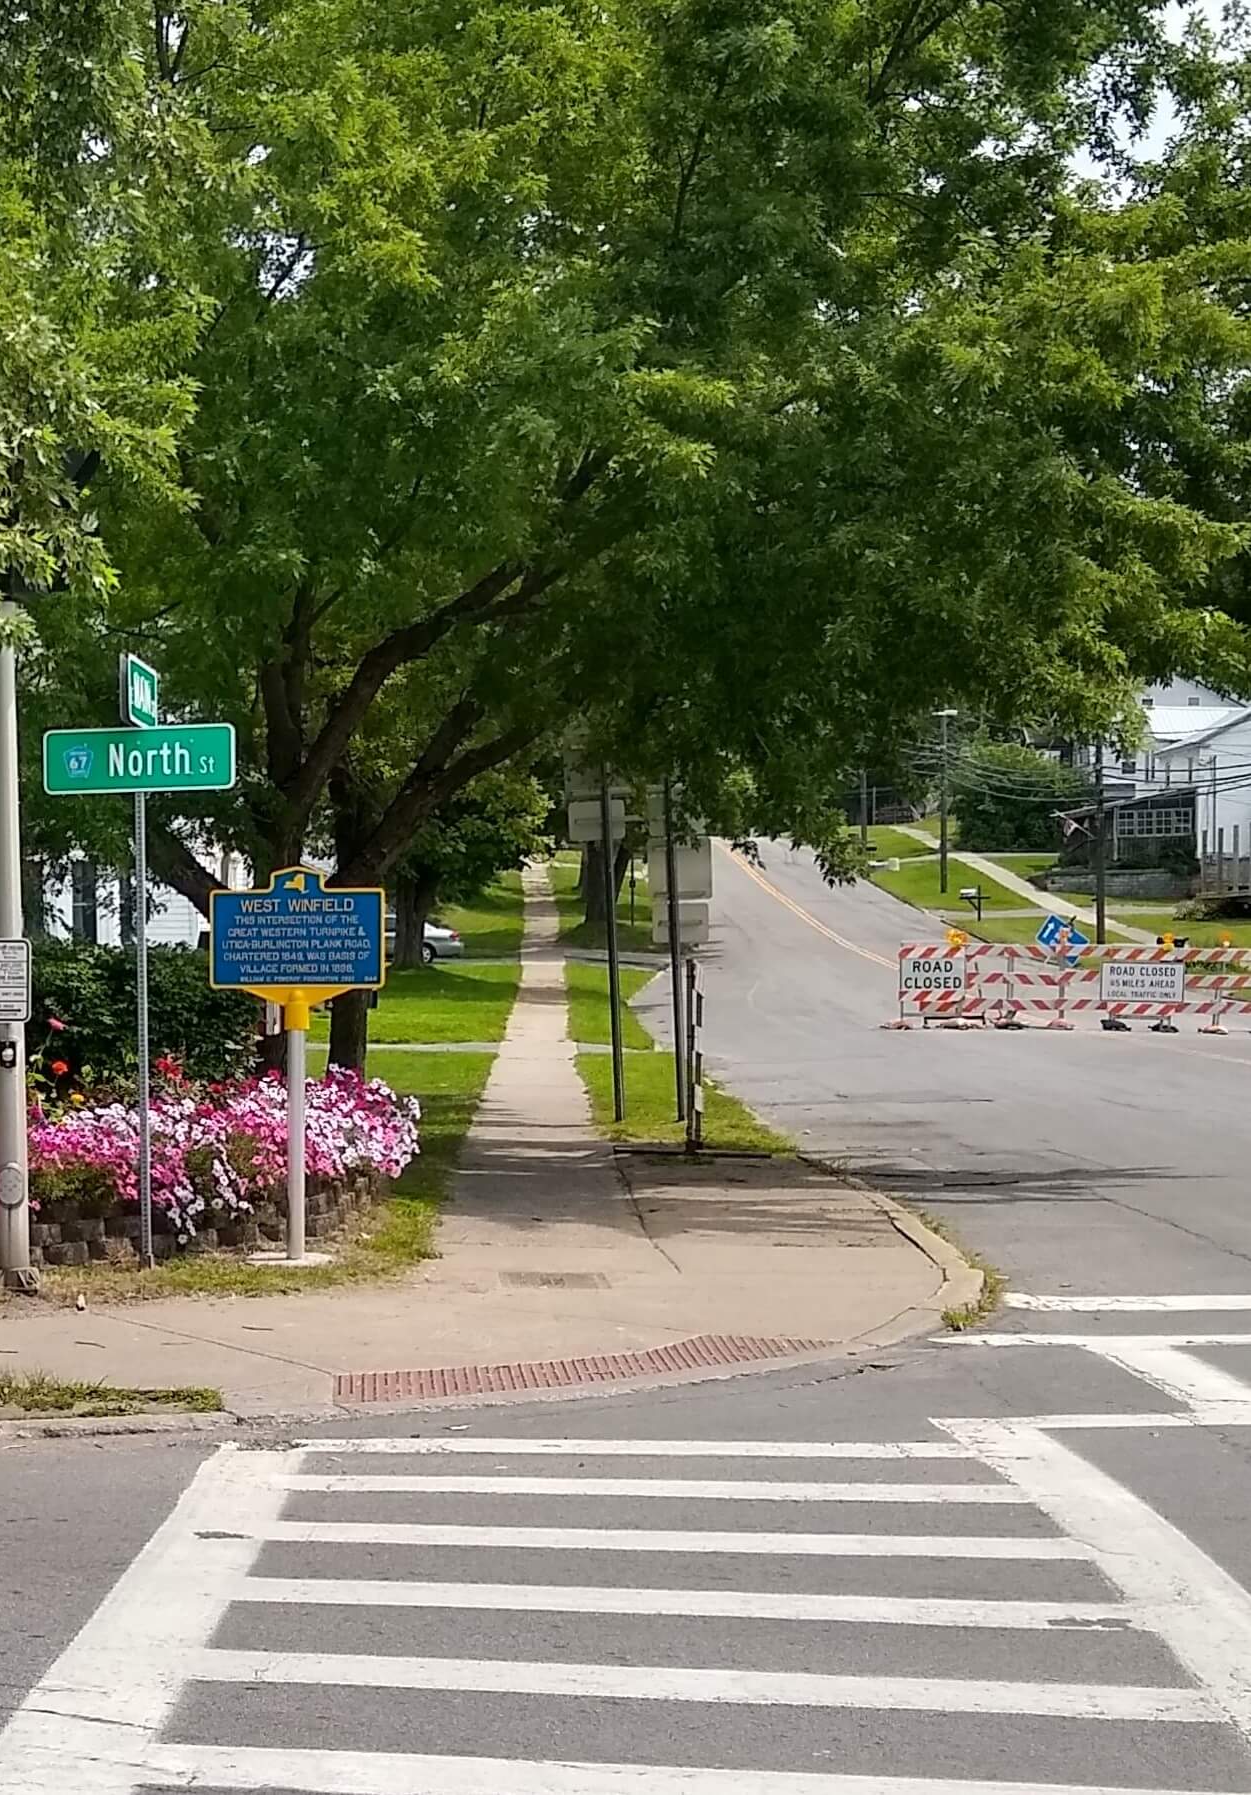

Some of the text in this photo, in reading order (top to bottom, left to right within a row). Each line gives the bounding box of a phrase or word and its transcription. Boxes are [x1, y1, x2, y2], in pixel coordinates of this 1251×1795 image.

[69, 741, 215, 777] 67 North St
[240, 898, 354, 913] WEST WINFIELD
[234, 914, 360, 925] THIS INTERSECTION OF THE
[227, 926, 366, 937] GREAT WESTERN TURNPIKE &
[222, 940, 309, 950] UTICA-BURLINGTON
[310, 940, 342, 949] PLANK
[223, 952, 280, 961] CHARTERED
[306, 951, 326, 960] WAS
[328, 951, 356, 960] BASIS
[357, 951, 371, 960] OF
[239, 964, 279, 974] VILLAGE
[280, 964, 318, 973] FORMED
[320, 964, 330, 973] IN
[912, 961, 953, 973] ROAD
[1109, 966, 1176, 977] ROAD CLOSED
[904, 977, 962, 989] CLOSED
[1122, 980, 1145, 988] MILES
[1149, 980, 1176, 988] AHEAD
